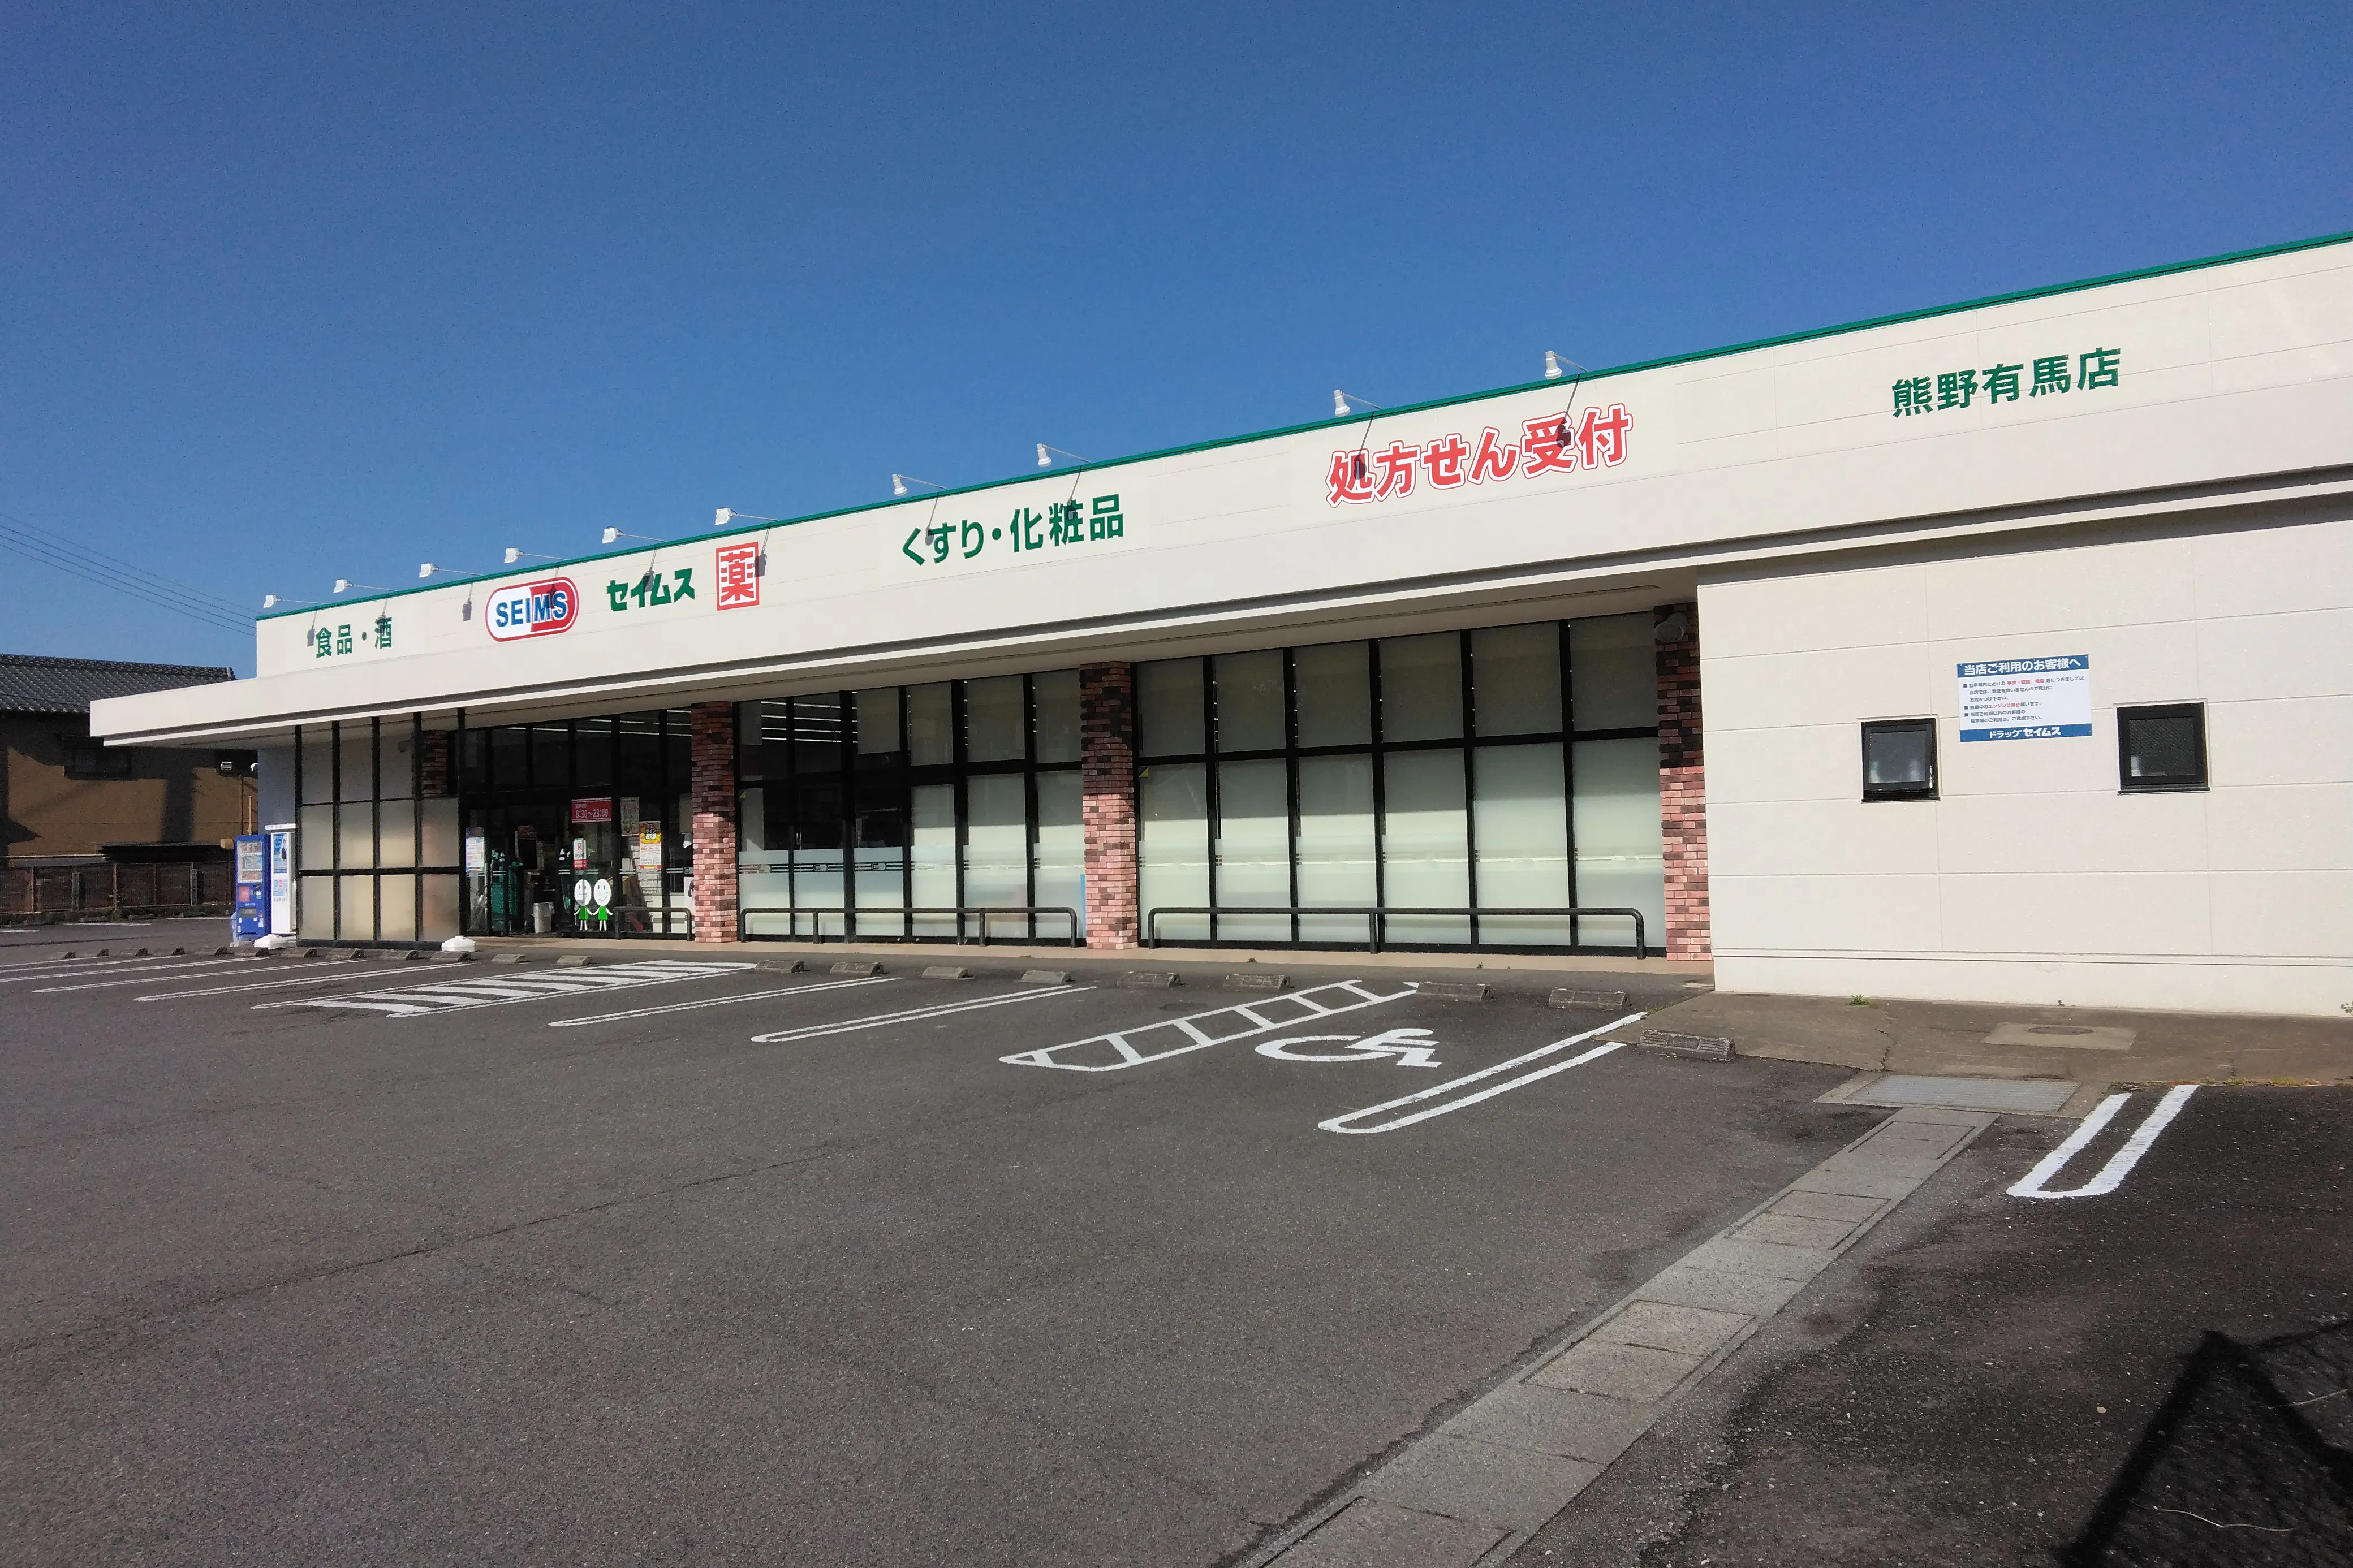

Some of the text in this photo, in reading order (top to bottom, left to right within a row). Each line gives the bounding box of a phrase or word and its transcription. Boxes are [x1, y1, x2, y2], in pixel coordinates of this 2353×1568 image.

[1891, 347, 2121, 418] 熊野有馬店
[1326, 404, 1632, 507] 処方せん受付
[902, 494, 1124, 566] くすり・化粧品
[606, 568, 695, 611] セイムス
[720, 550, 754, 603] 薬
[495, 591, 568, 628] SEIMS
[316, 616, 392, 658] 食品・酒
[1964, 658, 2081, 675] 当店ご利用のお客様へ
